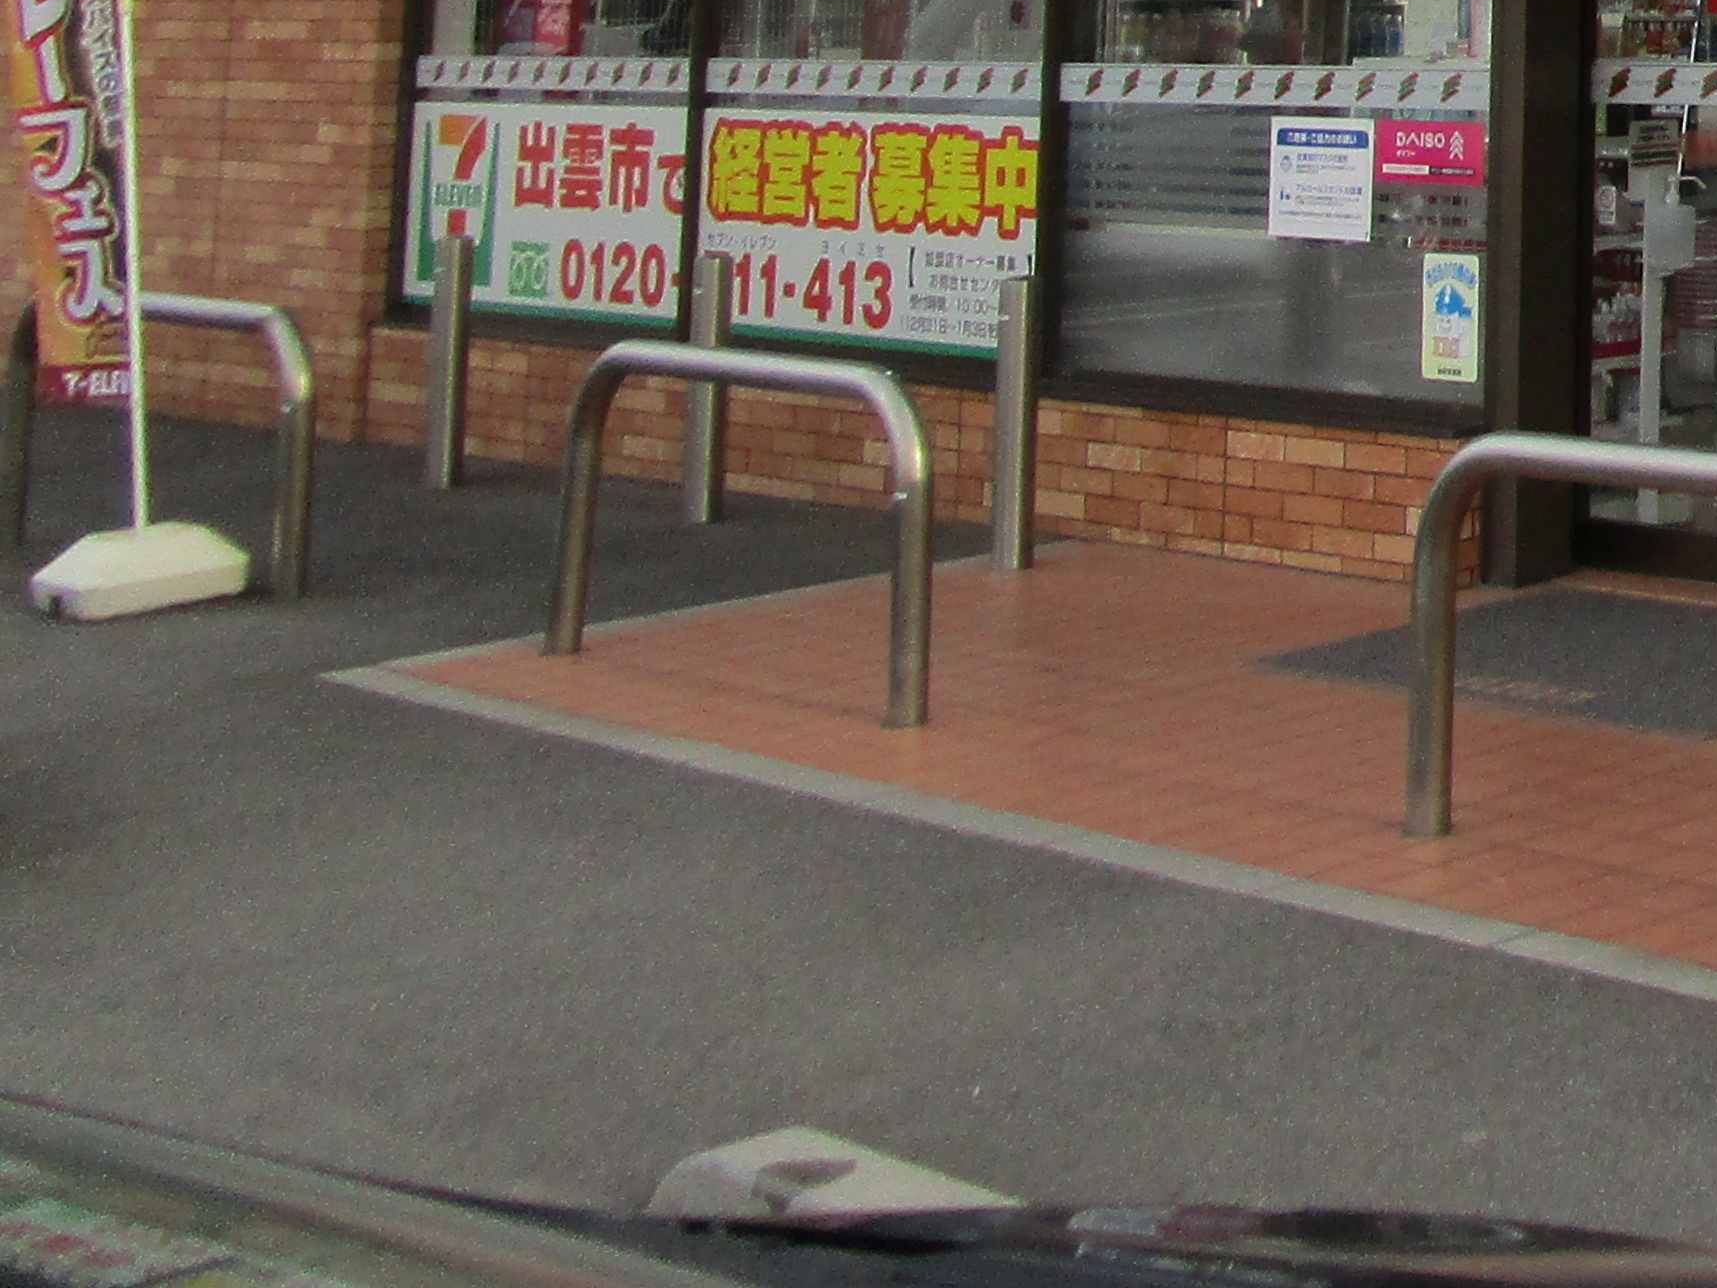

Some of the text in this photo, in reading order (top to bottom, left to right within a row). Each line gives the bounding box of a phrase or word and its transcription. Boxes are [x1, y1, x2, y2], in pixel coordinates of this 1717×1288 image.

[1395, 131, 1446, 149] DAISO
[707, 116, 1039, 240] 経営者募集中
